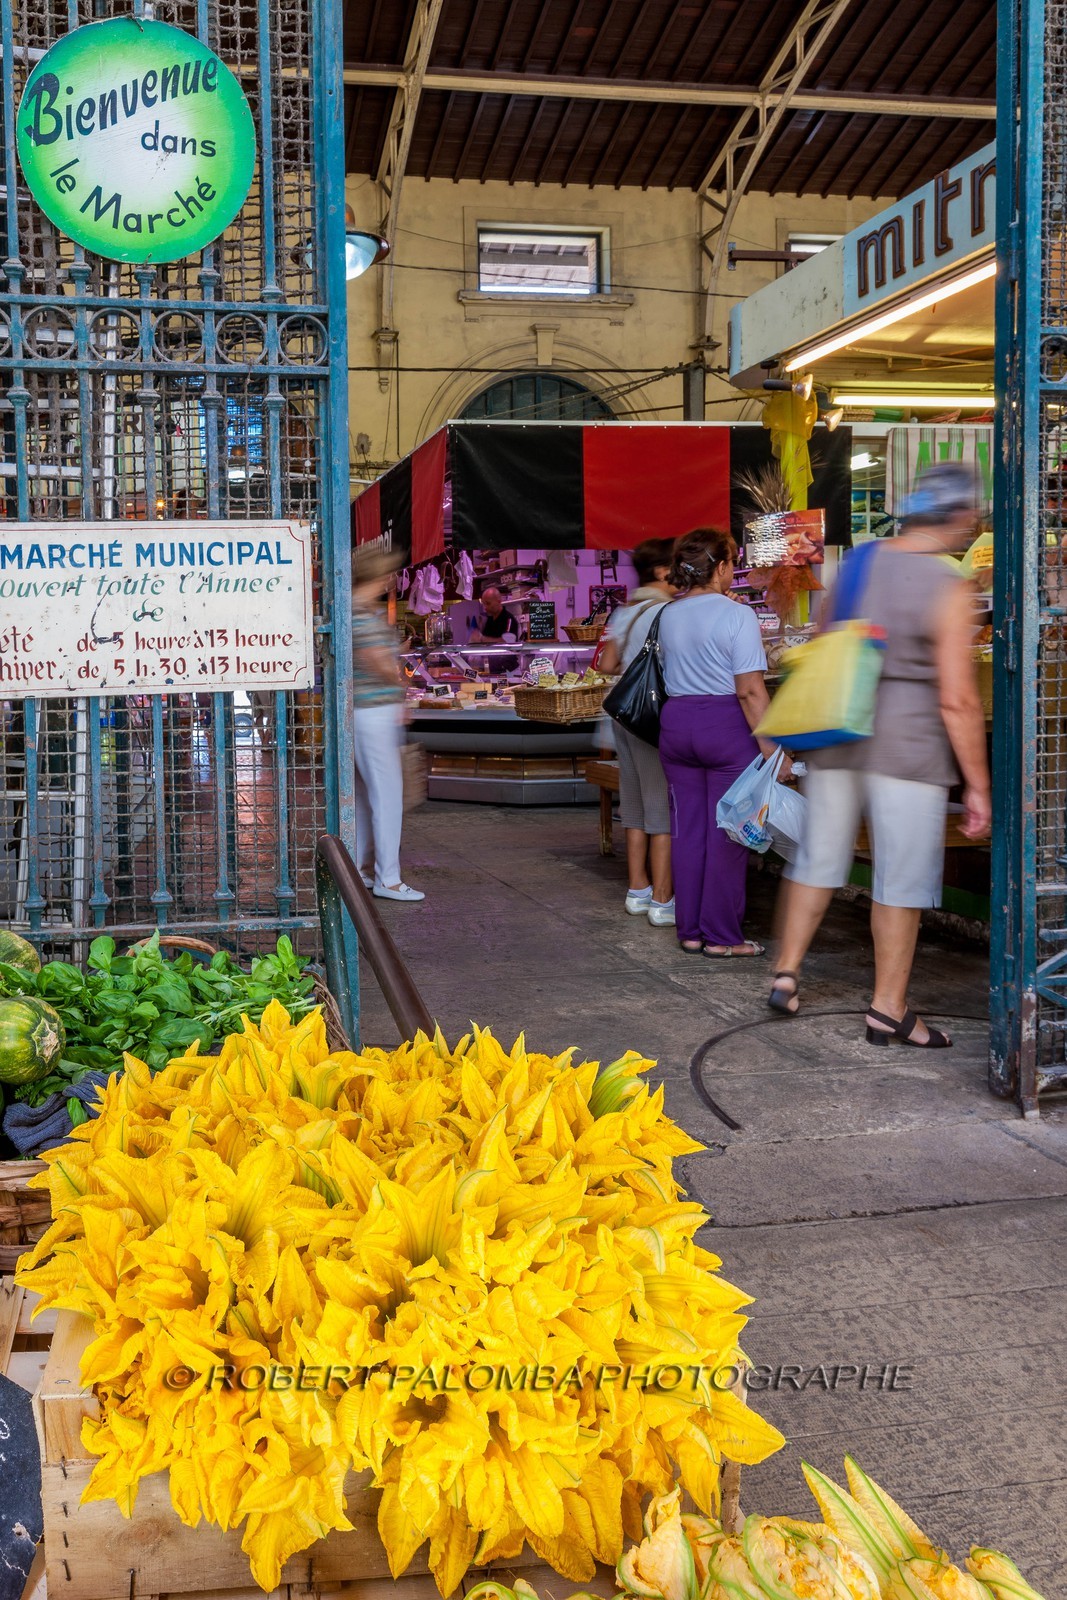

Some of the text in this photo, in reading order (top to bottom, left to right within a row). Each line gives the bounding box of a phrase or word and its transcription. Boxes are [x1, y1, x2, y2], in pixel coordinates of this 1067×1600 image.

[24, 57, 218, 147] Bienvenue
[140, 119, 217, 158] dans
[49, 157, 217, 234] le Marché
[0, 540, 292, 569] MARCHÉ MUNICIPAL
[97, 572, 165, 596] toute
[113, 631, 125, 651] 5
[77, 660, 100, 679] de
[113, 659, 125, 677] 5
